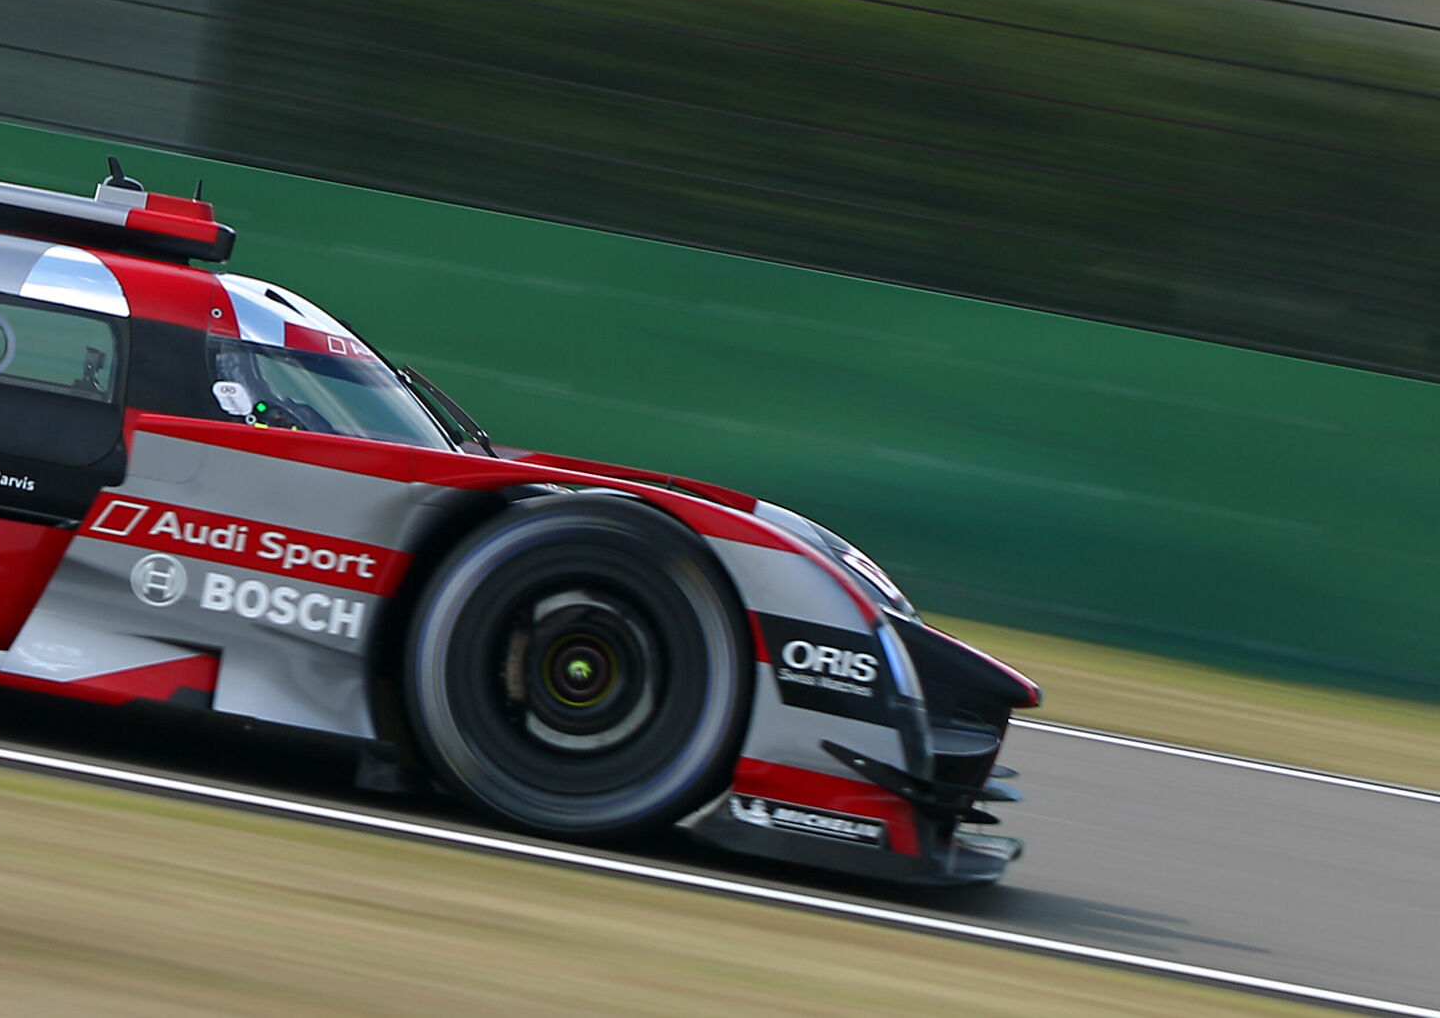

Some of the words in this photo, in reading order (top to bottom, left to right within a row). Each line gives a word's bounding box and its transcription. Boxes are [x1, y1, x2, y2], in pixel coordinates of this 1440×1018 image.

[148, 511, 248, 553] Audi
[256, 532, 377, 580] Sport
[199, 572, 366, 640] BOSCH
[781, 640, 879, 682] ORIS
